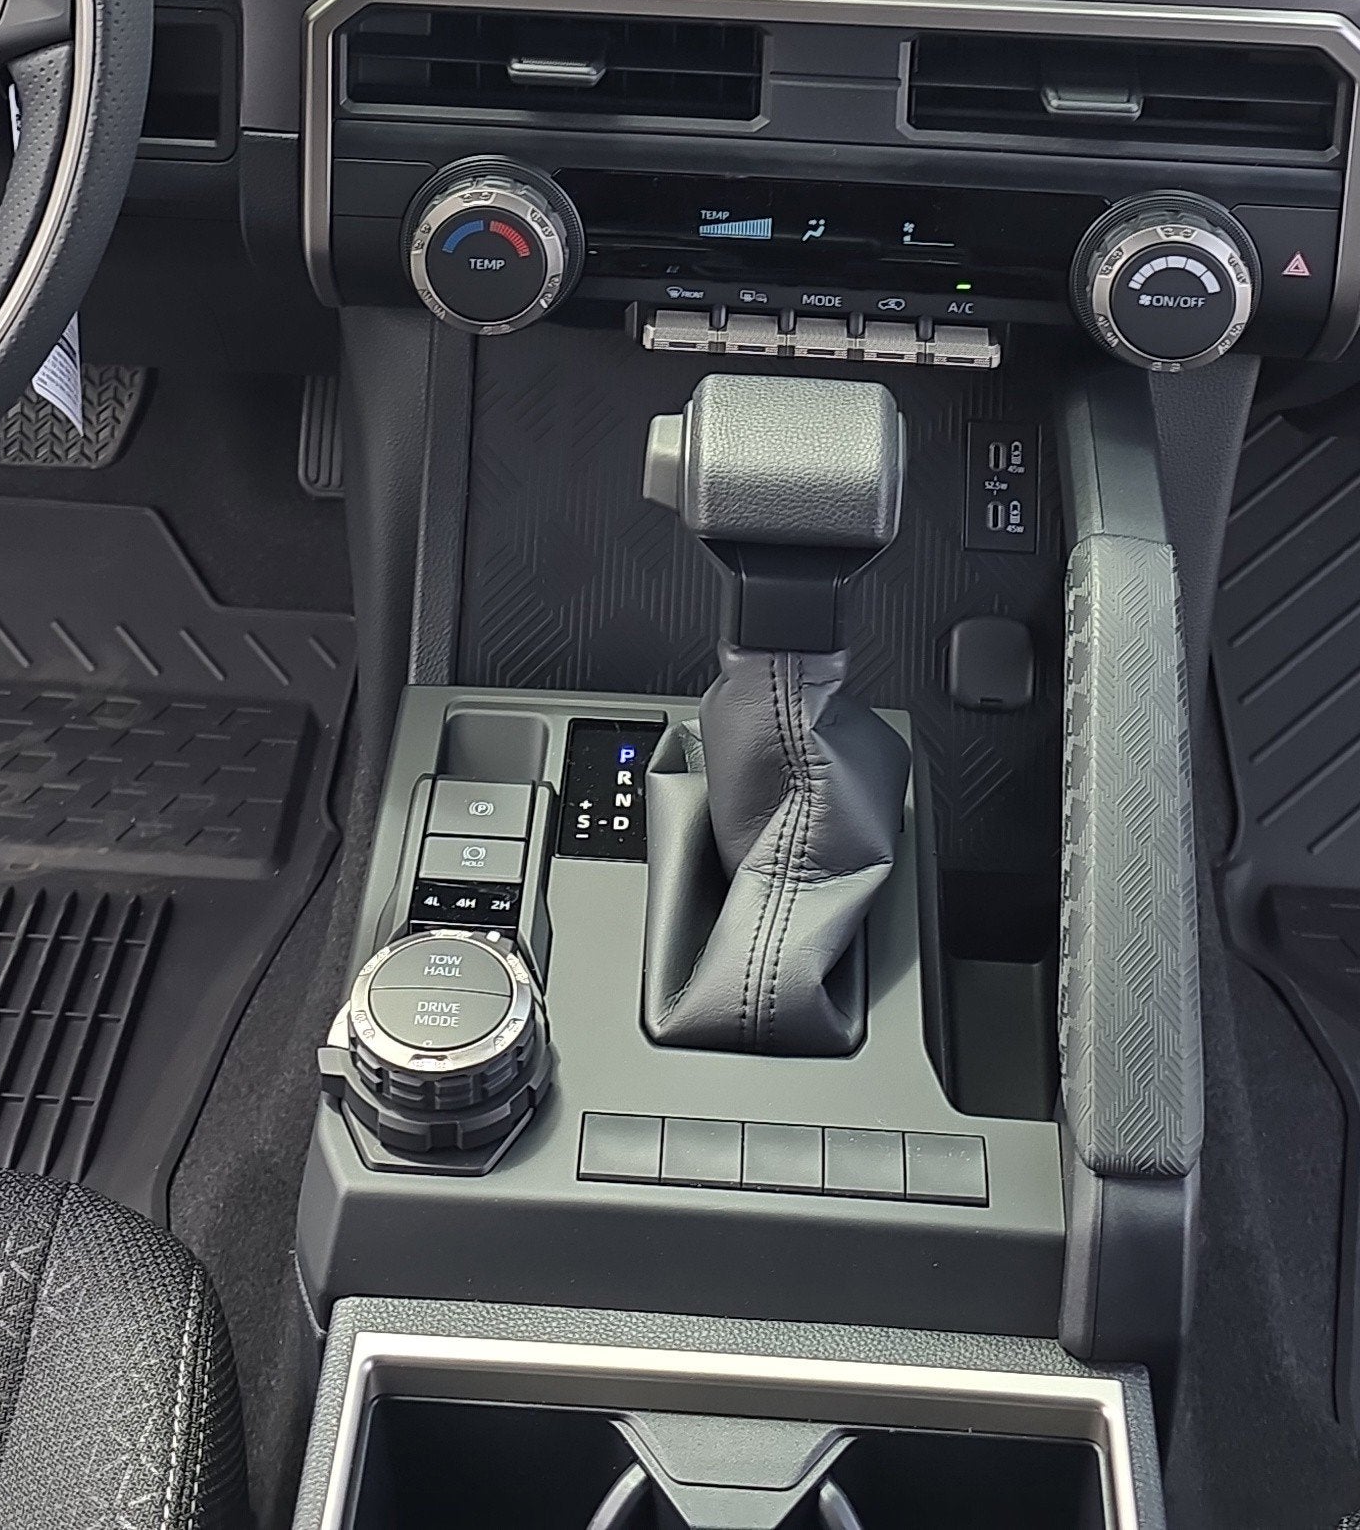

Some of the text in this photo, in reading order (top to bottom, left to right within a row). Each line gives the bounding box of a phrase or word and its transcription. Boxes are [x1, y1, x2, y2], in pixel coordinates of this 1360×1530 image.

[700, 209, 730, 220] TEMP
[469, 258, 506, 271] TEMP
[802, 294, 842, 308] MODE
[1152, 296, 1206, 308] ON/OFF
[947, 302, 974, 314] A/C
[620, 748, 635, 764] P
[617, 770, 633, 785] R
[615, 793, 632, 808] N
[577, 814, 630, 830] S D
[423, 896, 511, 911] 4L 4H 2H
[428, 954, 462, 965] TOW
[423, 966, 462, 977] HAUL
[417, 1001, 461, 1014] DRIVE
[413, 1014, 460, 1027] MODE
